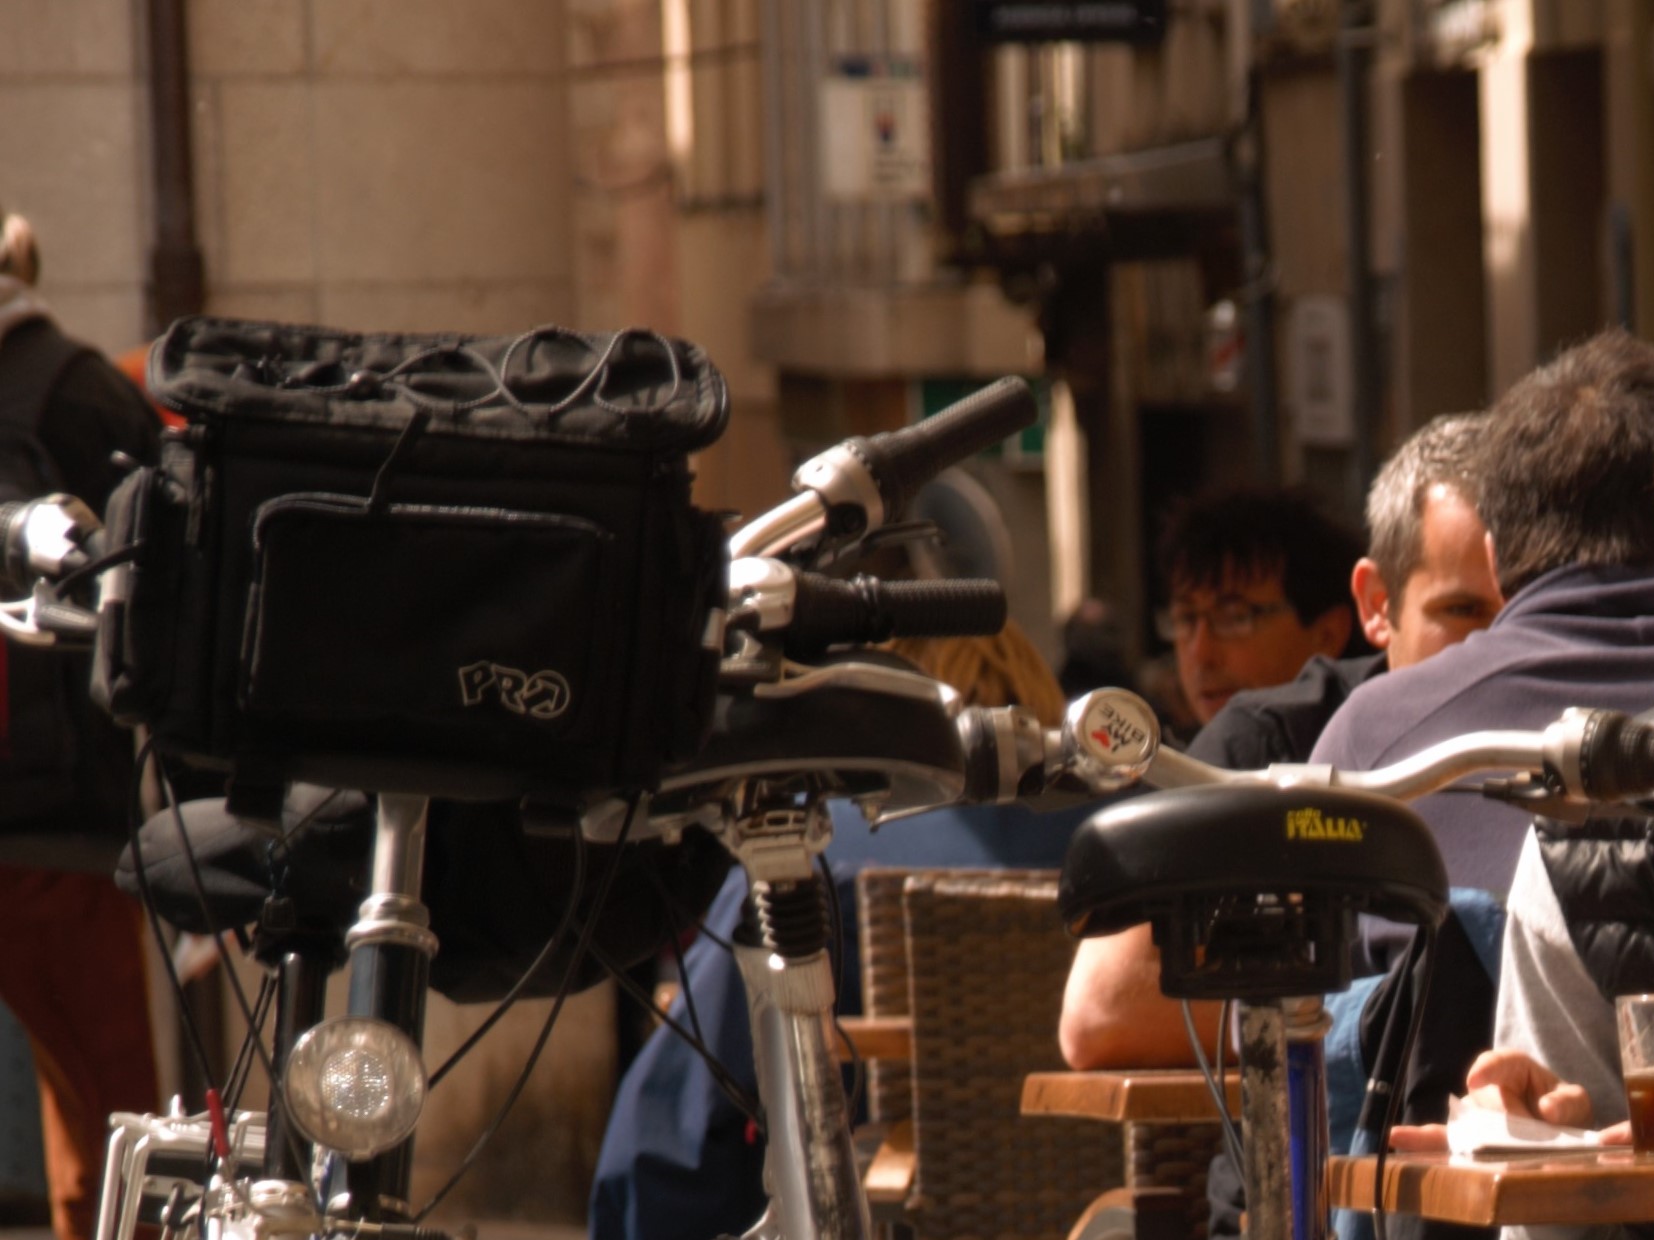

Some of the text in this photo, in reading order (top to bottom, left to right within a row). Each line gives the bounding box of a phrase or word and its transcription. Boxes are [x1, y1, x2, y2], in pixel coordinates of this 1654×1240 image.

[458, 659, 571, 719] PRO
[1100, 703, 1145, 743] BIKE
[1102, 723, 1132, 746] MY
[1287, 815, 1363, 841] ITALIA
